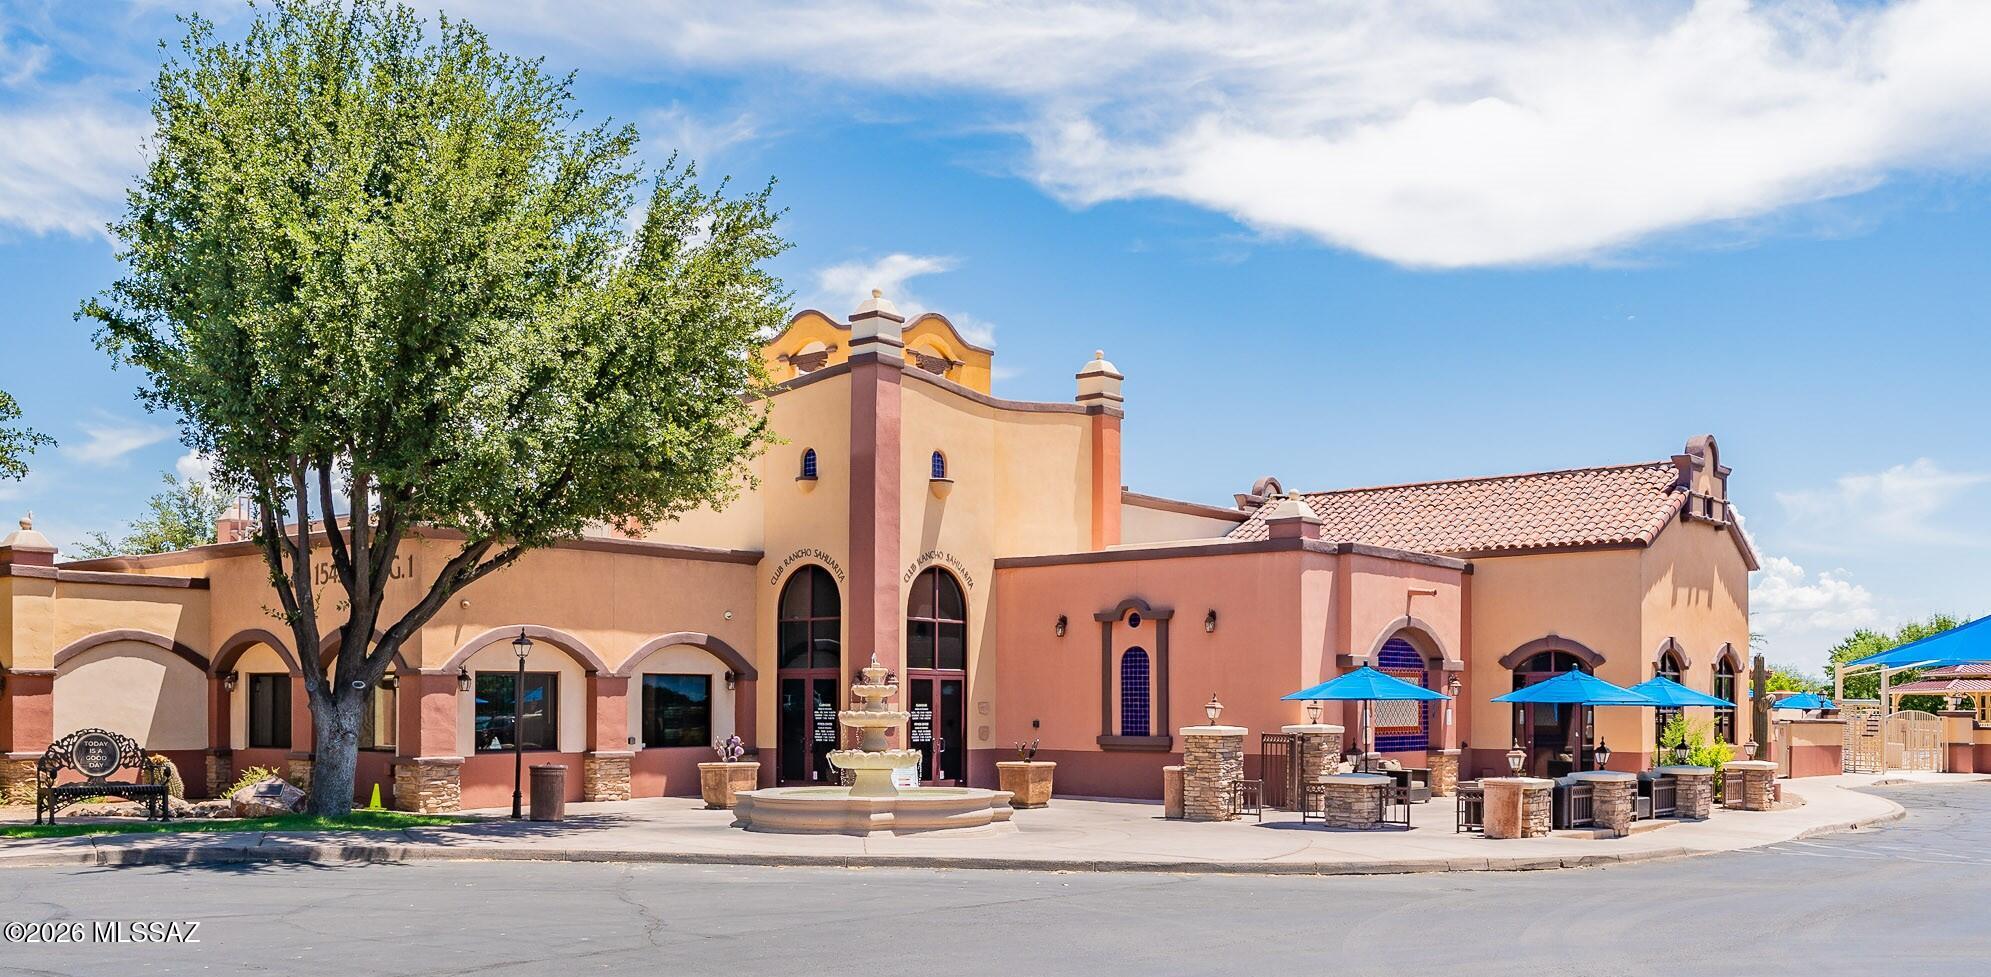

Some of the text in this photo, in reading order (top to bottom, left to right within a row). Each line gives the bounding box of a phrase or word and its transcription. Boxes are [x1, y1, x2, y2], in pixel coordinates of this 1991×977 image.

[314, 562, 342, 585] 154
[770, 548, 846, 586] CLUB RANCHO SAHUARITA
[903, 563, 917, 583] CLUB
